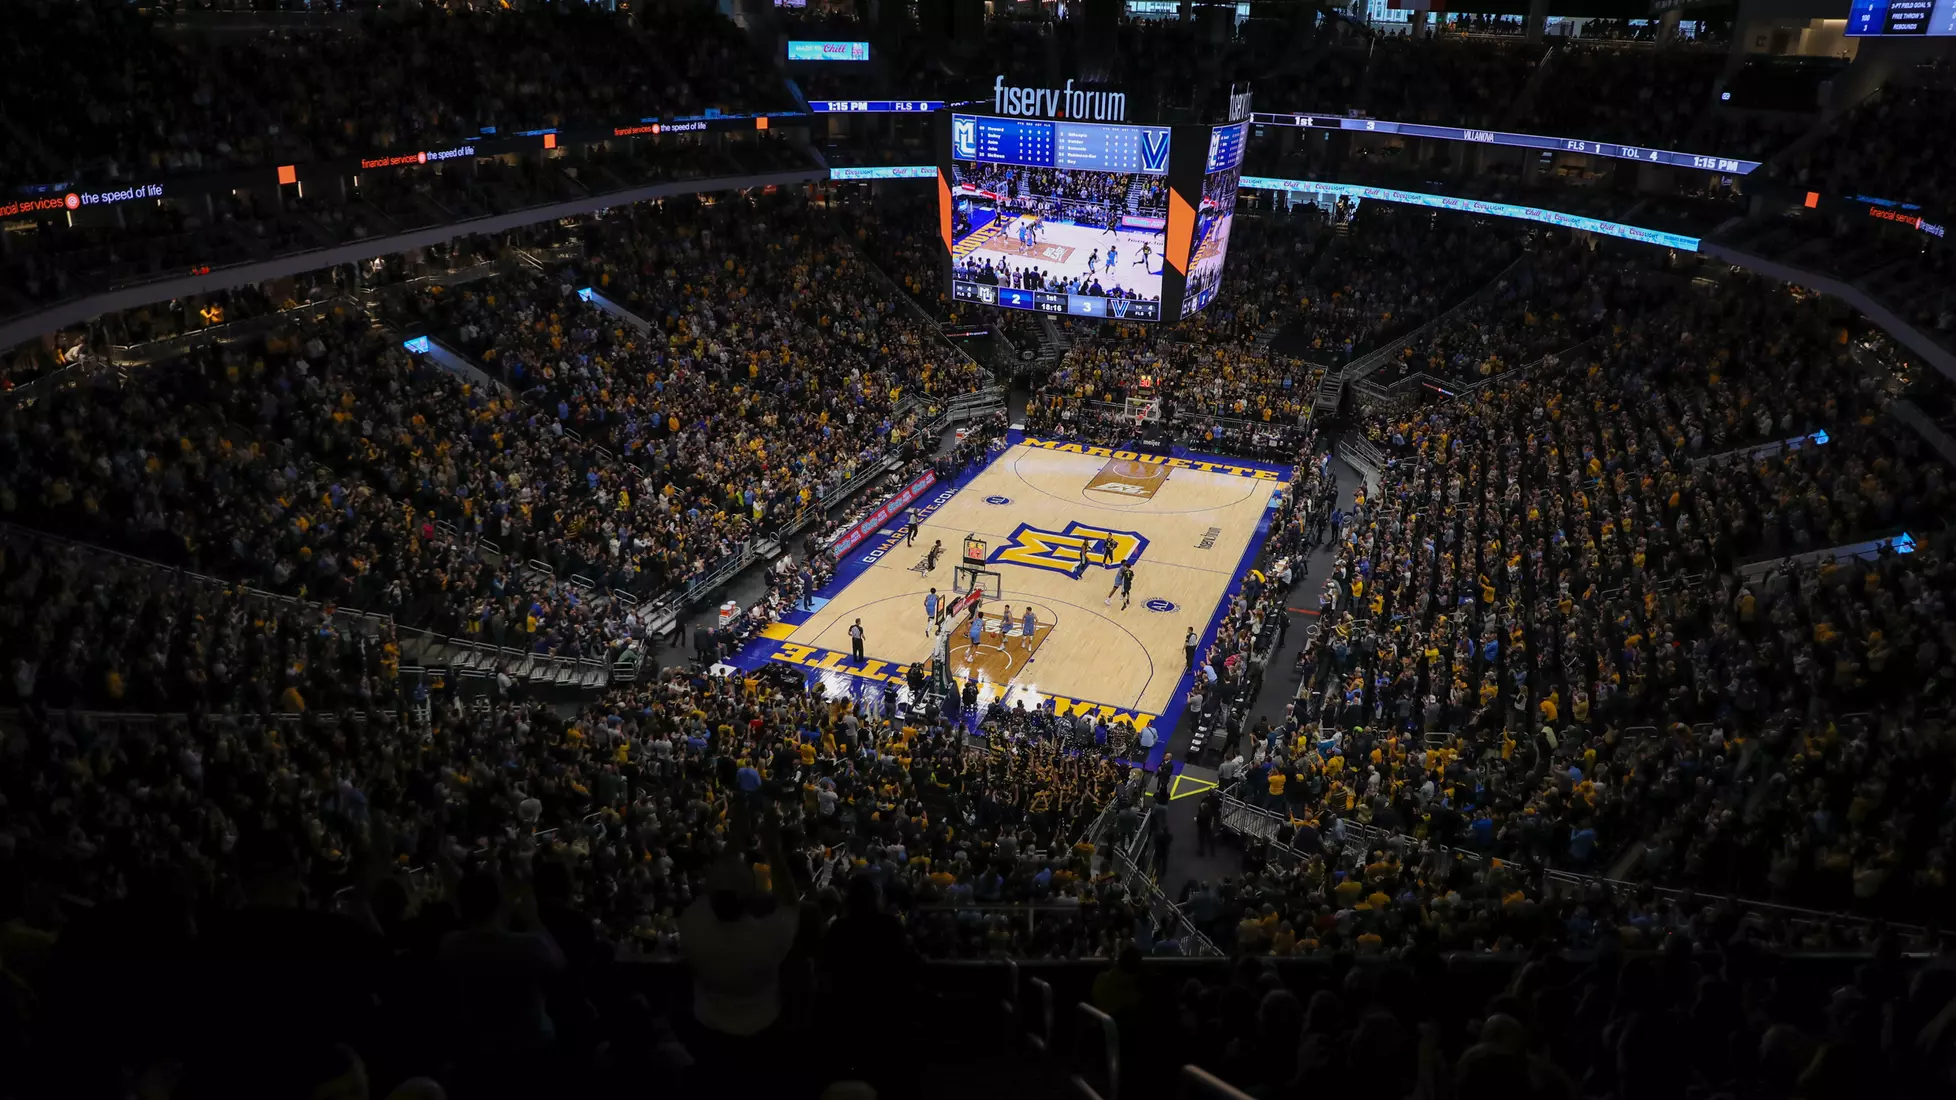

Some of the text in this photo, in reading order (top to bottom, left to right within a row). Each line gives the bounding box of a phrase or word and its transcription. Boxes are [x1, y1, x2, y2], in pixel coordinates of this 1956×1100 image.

[823, 44, 848, 53] Chill
[828, 102, 868, 111] 1:15 PM
[896, 102, 928, 111] FLS 0
[660, 123, 671, 132] the
[671, 123, 690, 133] speed
[690, 122, 698, 131] of
[697, 122, 707, 130] life
[1294, 116, 1313, 127] 1st
[1366, 119, 1375, 131] 3
[1463, 130, 1494, 143] VILLANOVA
[1567, 140, 1600, 154] FLS 1
[361, 145, 475, 169] financial services the speed of life
[1621, 147, 1658, 161] TOL 4
[1693, 156, 1738, 172] 1:15 PM
[20, 197, 64, 213] services
[81, 193, 100, 205] the
[102, 187, 134, 204] speed
[135, 185, 148, 199] of
[148, 184, 162, 197] life
[1869, 205, 1896, 220] financial
[1011, 294, 1021, 305] 2
[1046, 294, 1058, 302] 1st
[1082, 302, 1092, 312] 3
[1019, 437, 1280, 481] MARQUETTE
[862, 488, 959, 564] GOMARQETTE.COM
